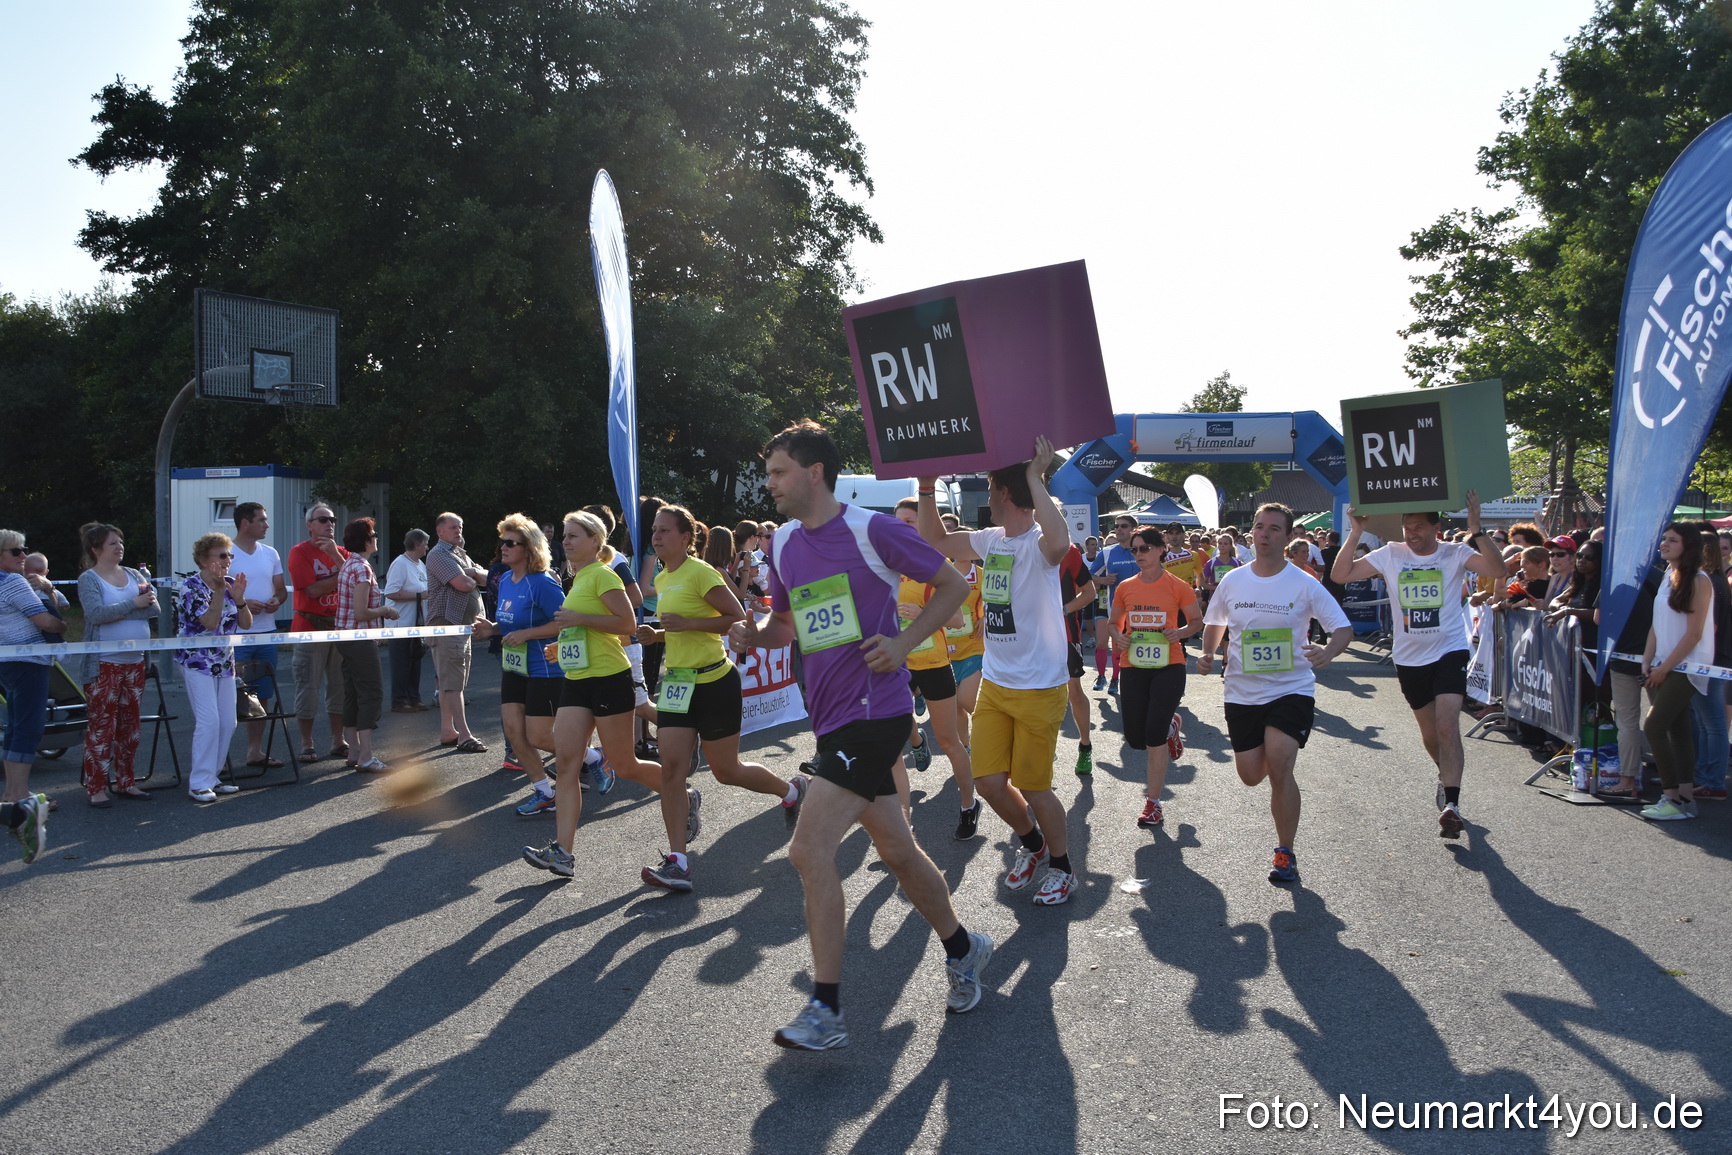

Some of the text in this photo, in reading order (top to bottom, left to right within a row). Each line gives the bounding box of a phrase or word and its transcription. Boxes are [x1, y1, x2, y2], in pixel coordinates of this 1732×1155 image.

[870, 322, 952, 408] RW NM
[886, 416, 971, 442] RAUMWERK
[1196, 436, 1256, 448] firmenlauf
[1362, 417, 1433, 469] RW NM
[1086, 458, 1117, 466] Fischer
[1367, 476, 1439, 491] RAUMWERK
[985, 574, 1008, 591] 1164
[1402, 585, 1439, 598] 1156
[1234, 601, 1290, 612] globalconcepts
[805, 603, 844, 634] 295
[988, 611, 1004, 627] RW
[1131, 614, 1163, 624] OBI
[1413, 610, 1432, 623] RW
[505, 653, 522, 667] 492
[561, 644, 580, 660] 643
[1135, 646, 1161, 659] 618
[1252, 646, 1281, 662] 531
[1517, 655, 1553, 695] Fischer
[666, 685, 688, 701] 647
